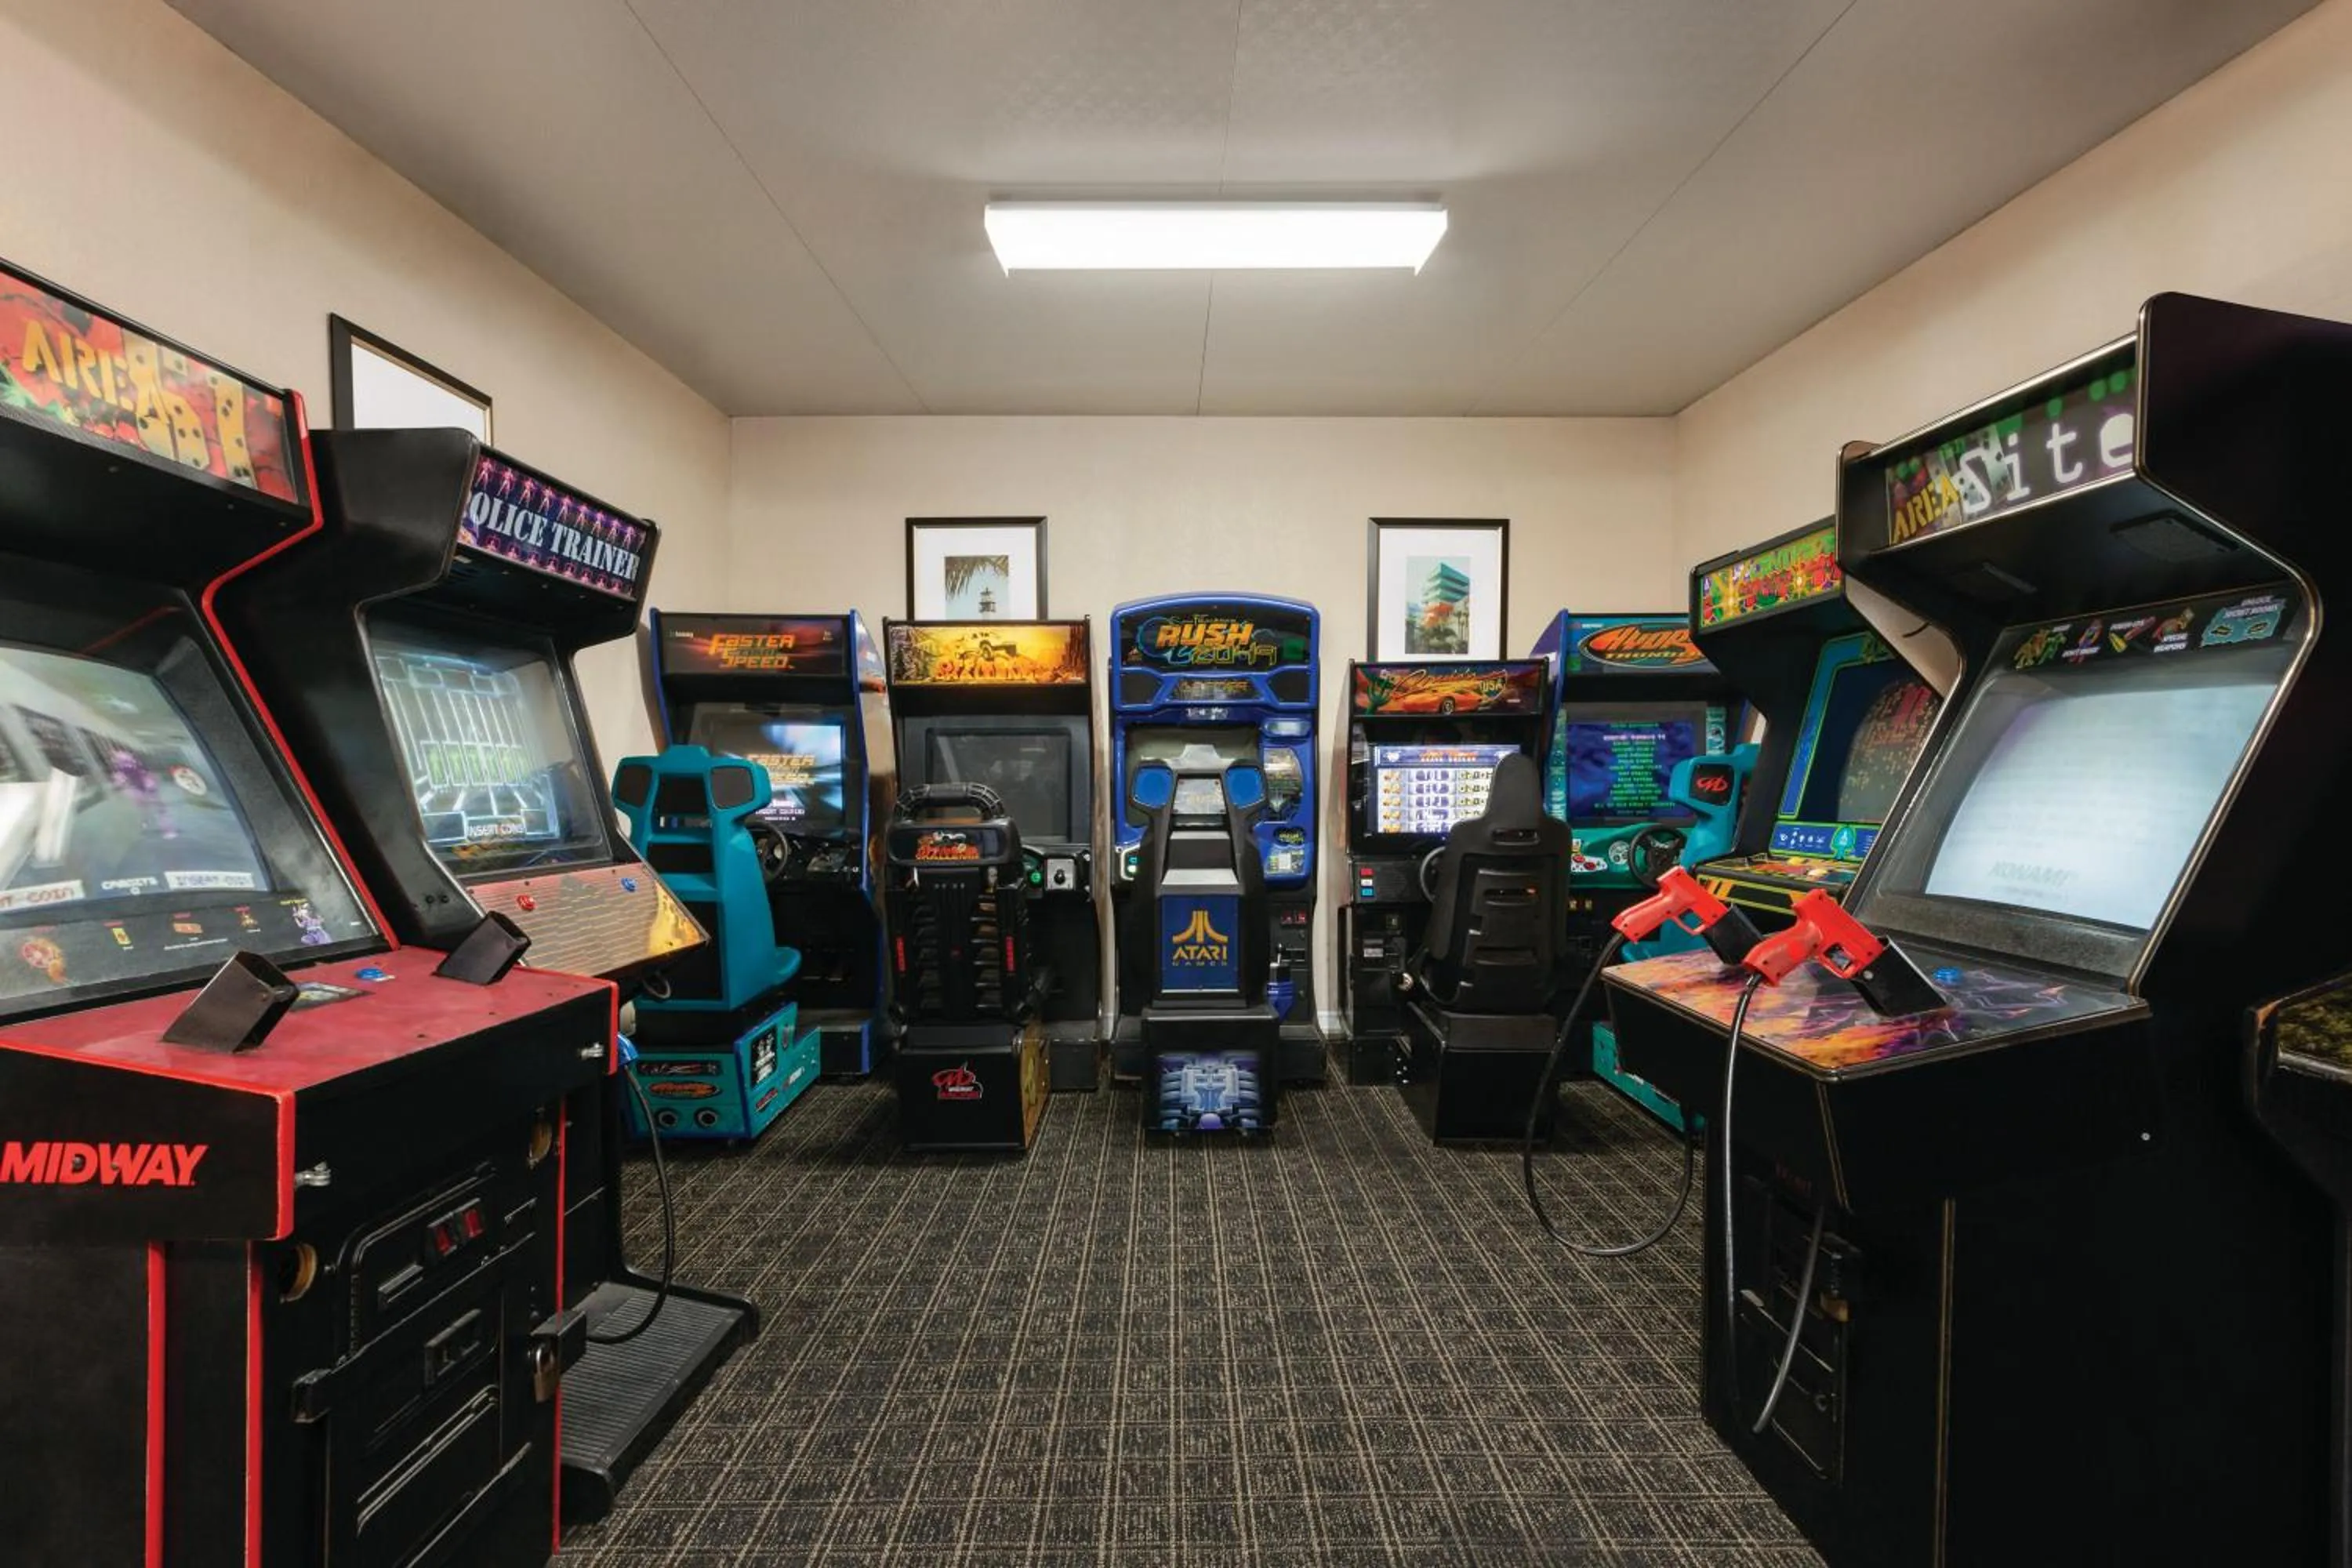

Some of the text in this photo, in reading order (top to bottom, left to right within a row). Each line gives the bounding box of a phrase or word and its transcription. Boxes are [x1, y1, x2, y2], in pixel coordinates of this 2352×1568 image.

[20, 318, 172, 426] AREA
[1892, 474, 1961, 544] AREA
[1958, 412, 2133, 514] Site
[464, 491, 641, 582] OLICE TRAINER
[708, 633, 796, 655] FASTER
[1156, 623, 1254, 648] RUSH
[1172, 945, 1228, 960] ATARI
[0, 1141, 209, 1186] MIDWAY
